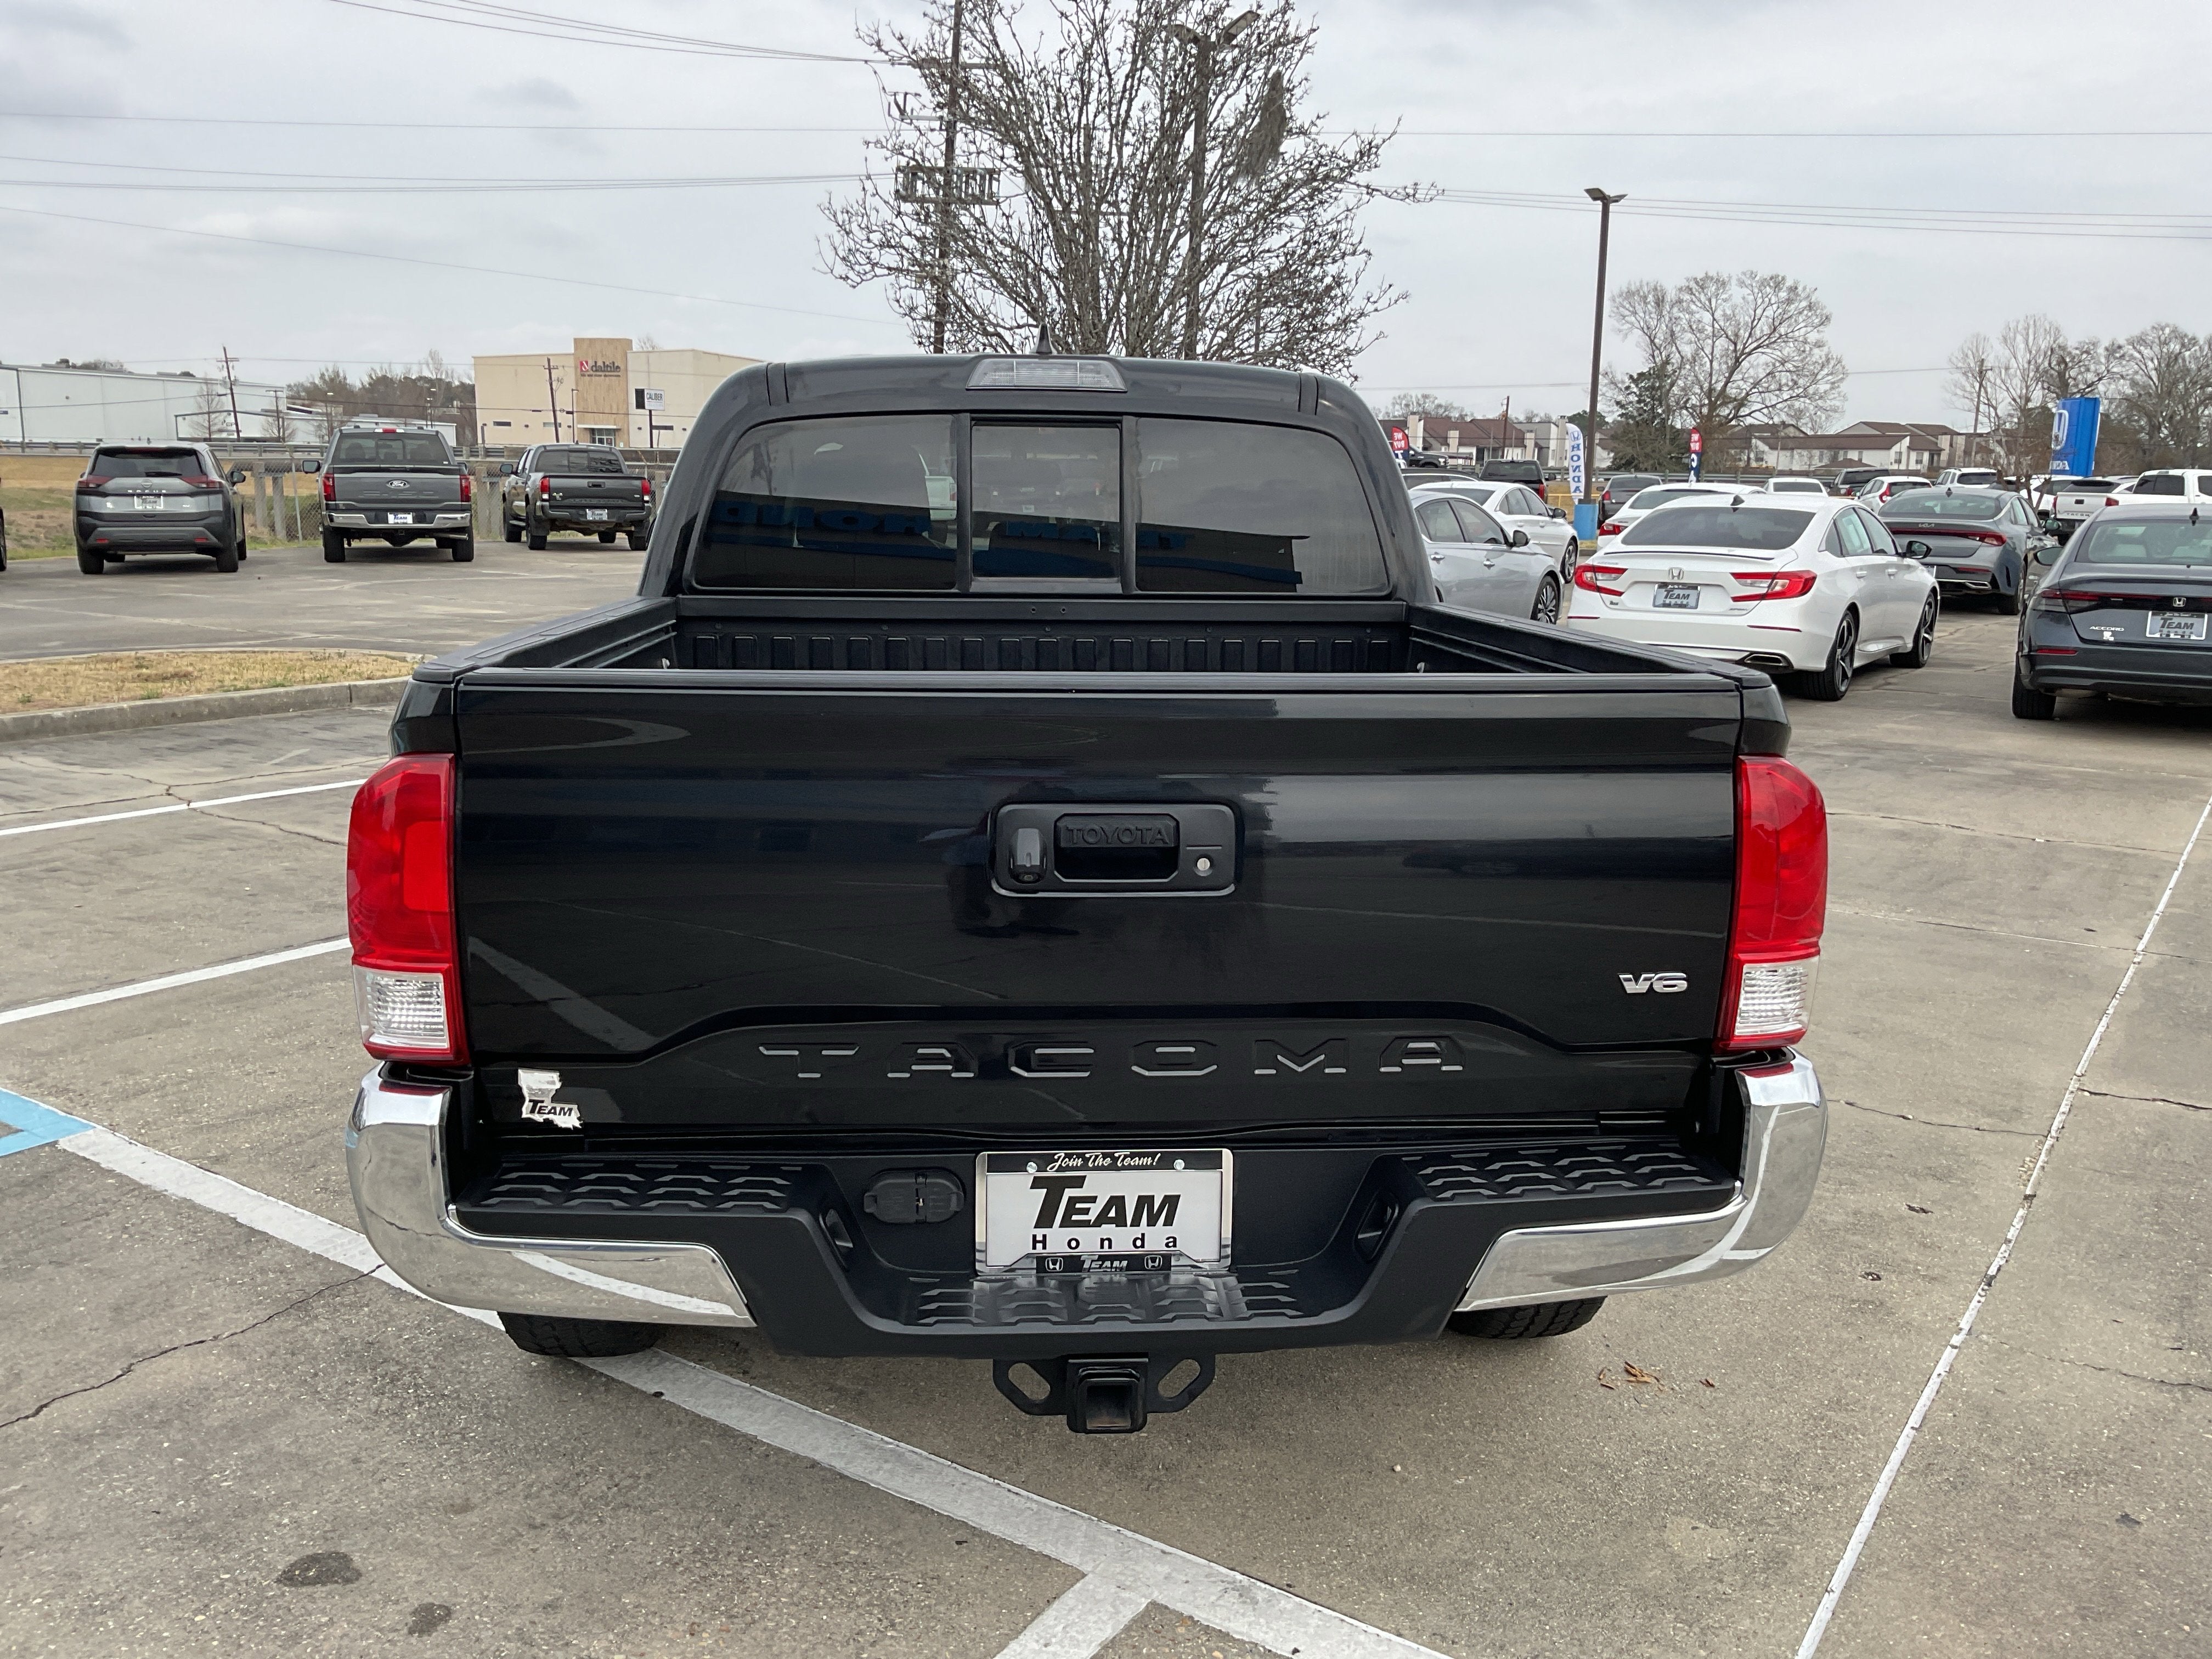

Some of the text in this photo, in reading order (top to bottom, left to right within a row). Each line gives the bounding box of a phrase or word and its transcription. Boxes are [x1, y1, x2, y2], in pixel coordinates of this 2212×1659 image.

[591, 360, 621, 373] daltile
[646, 392, 663, 401] CALIBER
[1664, 589, 1690, 600] TEAM
[2160, 617, 2194, 630] TEAM
[1066, 823, 1170, 845] TOYOTA
[1618, 971, 1688, 994] V6
[758, 1035, 1466, 1078] TACOMA
[529, 1099, 573, 1117] TEAM
[1047, 1152, 1161, 1172] Join The Team!
[1029, 1175, 1181, 1229] TEAM
[1031, 1233, 1178, 1251] Honda
[1080, 1255, 1128, 1272] TEAM
